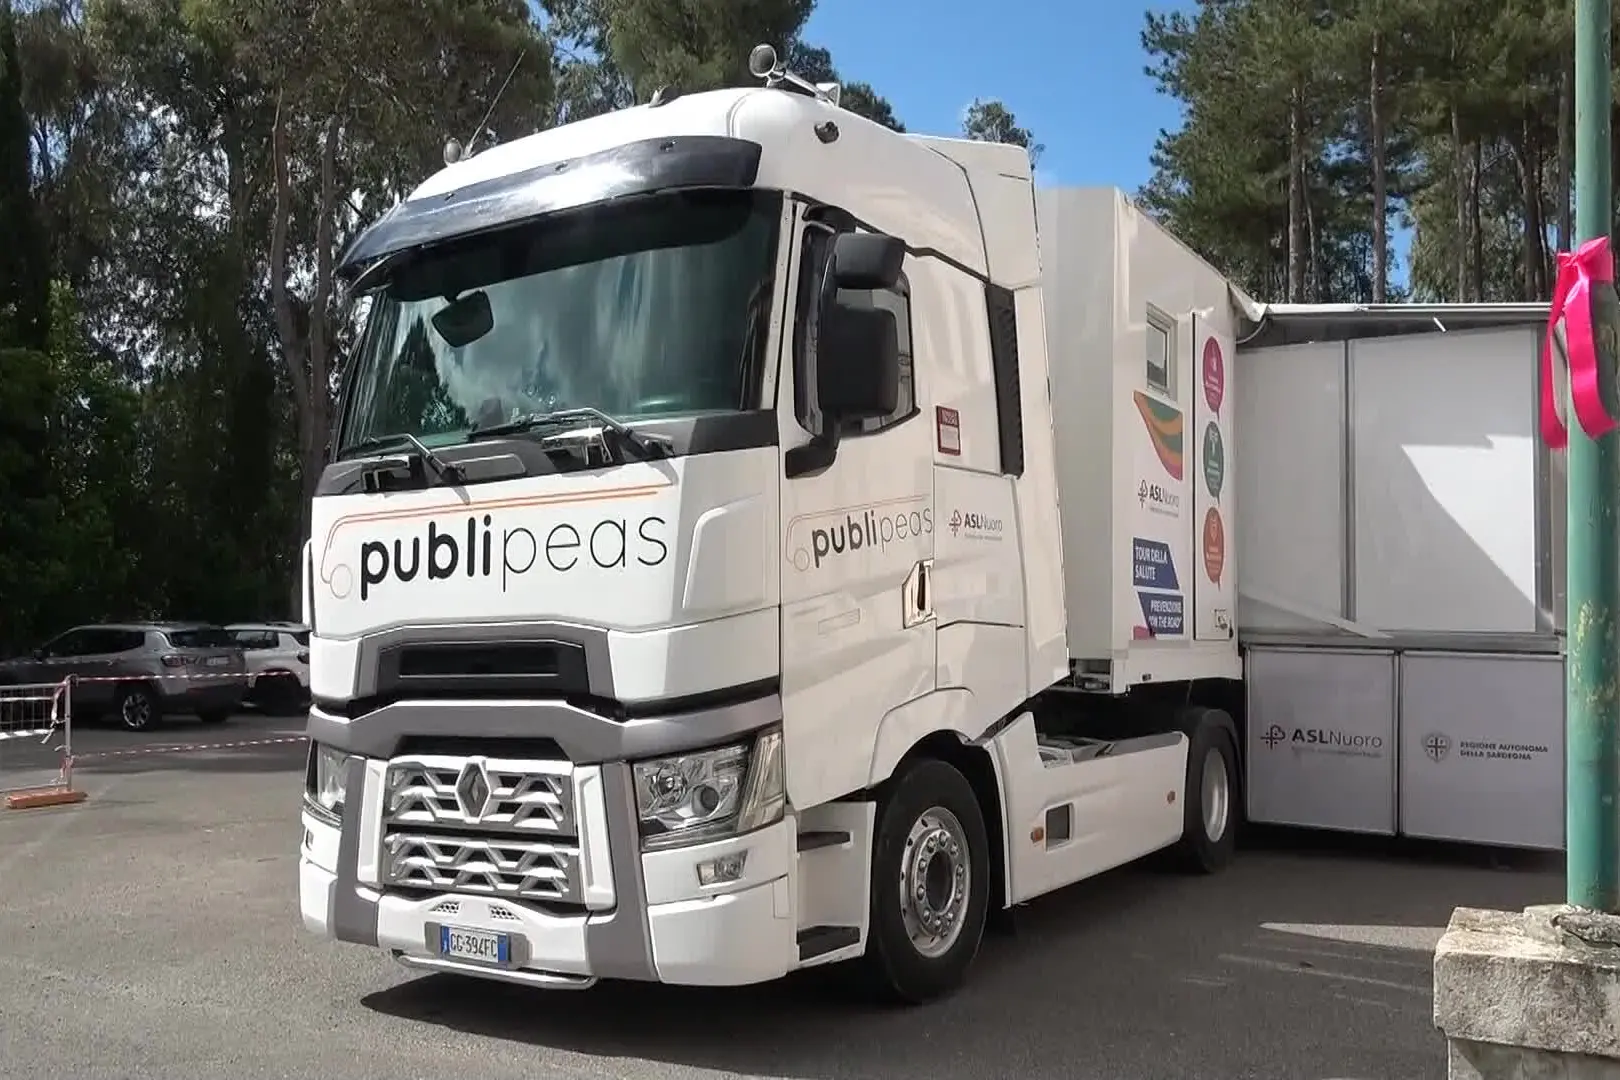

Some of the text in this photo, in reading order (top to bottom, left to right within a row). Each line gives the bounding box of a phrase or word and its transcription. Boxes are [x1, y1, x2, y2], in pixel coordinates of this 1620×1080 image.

[811, 507, 933, 569] publipeas
[360, 514, 669, 601] publipeas
[1134, 546, 1168, 564] TOUR DELLA
[1134, 564, 1156, 580] SALUTE
[1487, 751, 1532, 761] SARDEGNA
[1498, 743, 1548, 753] AUTONOMA
